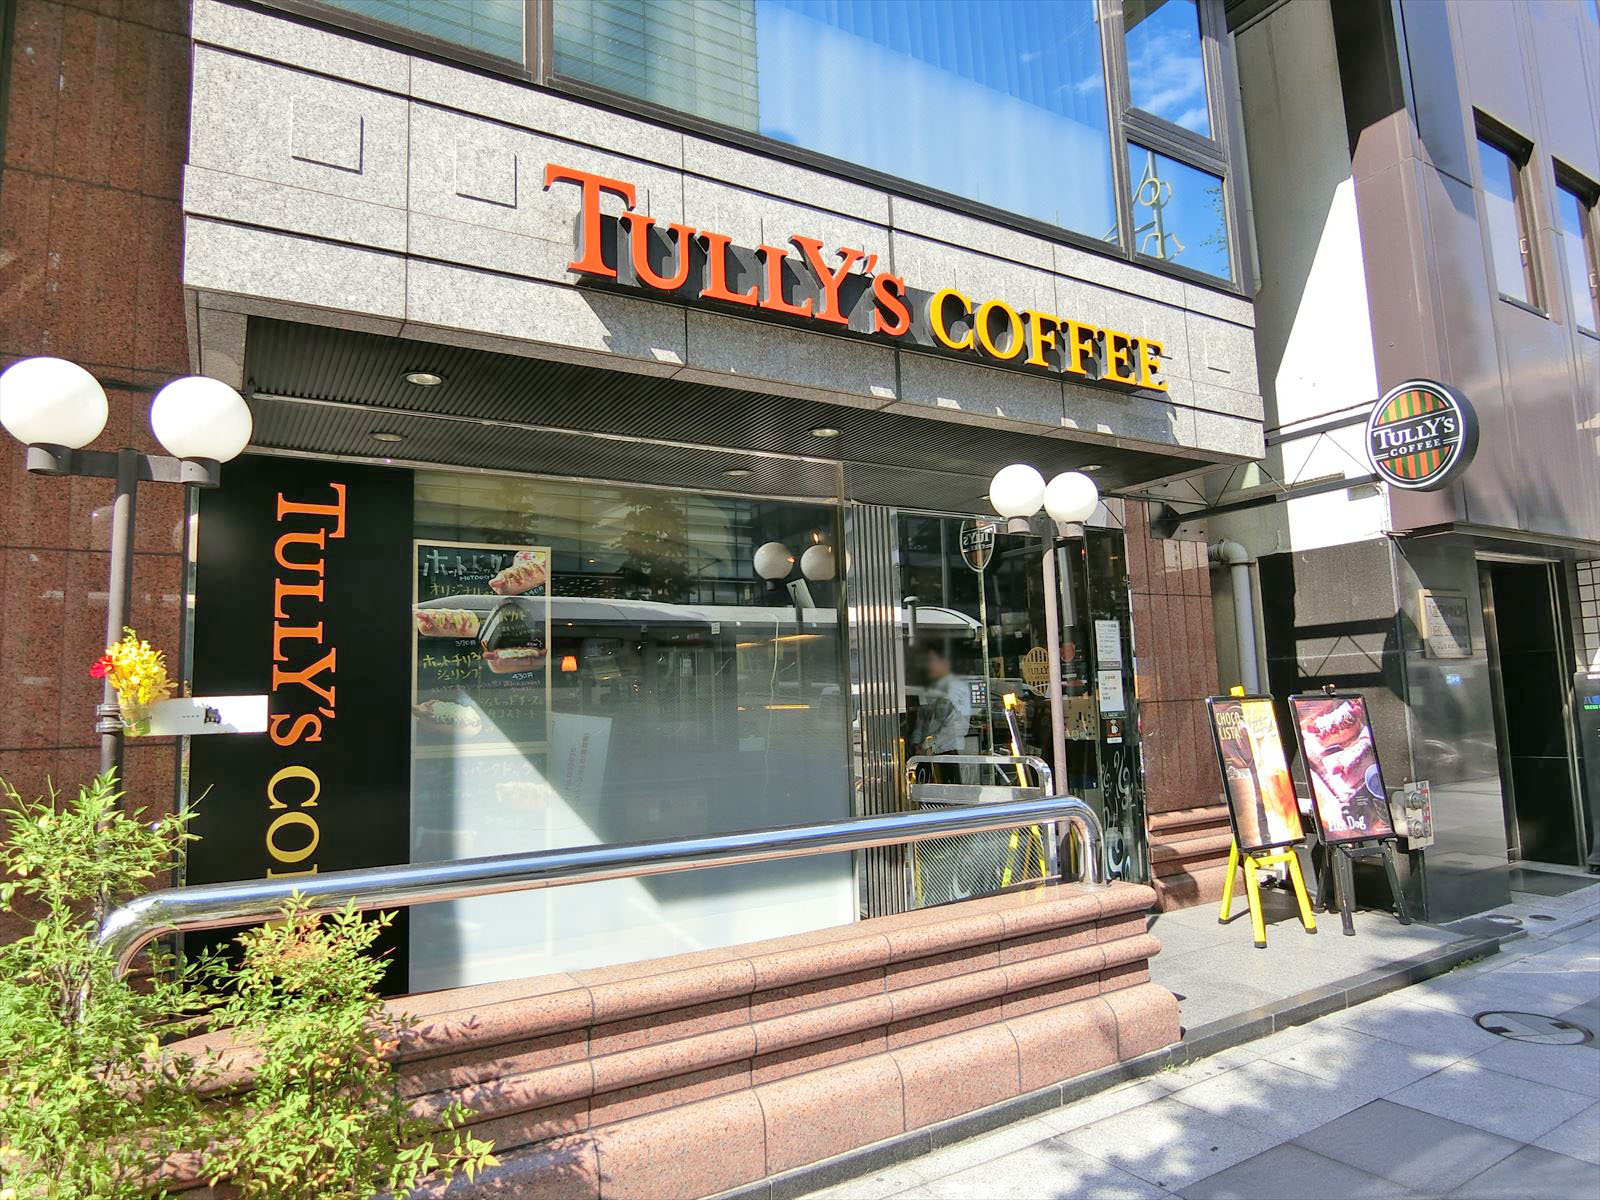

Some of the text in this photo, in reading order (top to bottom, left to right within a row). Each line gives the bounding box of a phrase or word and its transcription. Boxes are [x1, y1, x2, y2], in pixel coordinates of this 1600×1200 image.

[545, 163, 1168, 392] TULLY'S COFFEE
[1373, 416, 1455, 450] TULLY'S
[1390, 438, 1441, 457] COFFEE
[270, 483, 348, 748] TULLY'S
[1347, 815, 1367, 831] Dog
